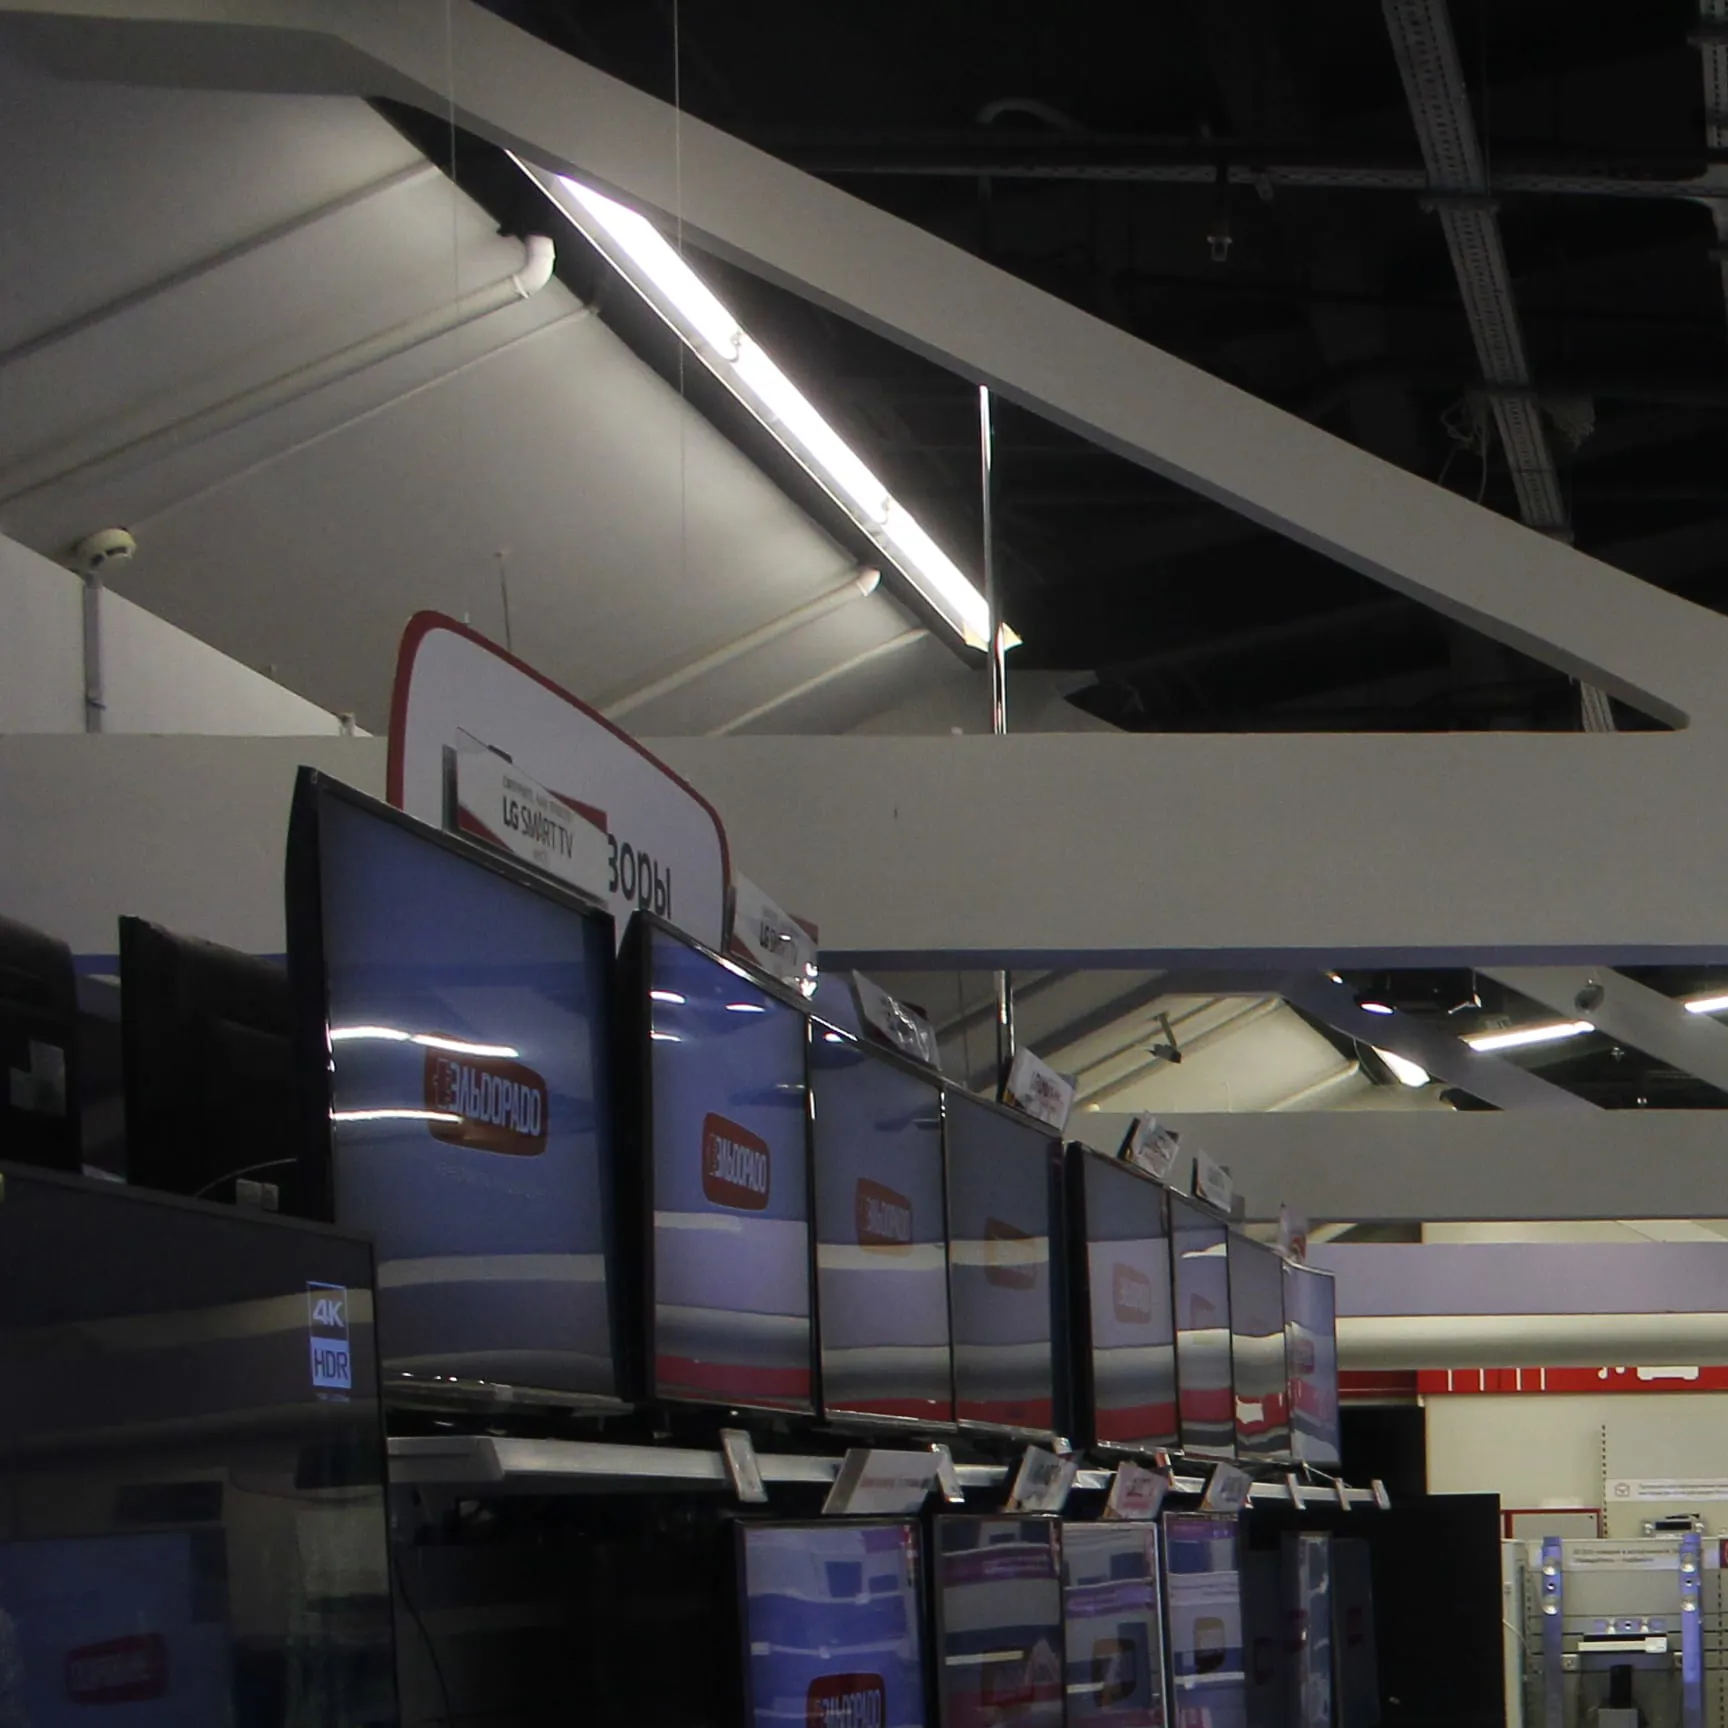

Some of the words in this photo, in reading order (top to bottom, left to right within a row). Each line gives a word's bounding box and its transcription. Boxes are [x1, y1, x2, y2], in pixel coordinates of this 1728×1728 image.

[503, 796, 519, 830] LG
[607, 832, 671, 919] зоры
[312, 1298, 345, 1328] 4K
[314, 1348, 349, 1381] HDR
